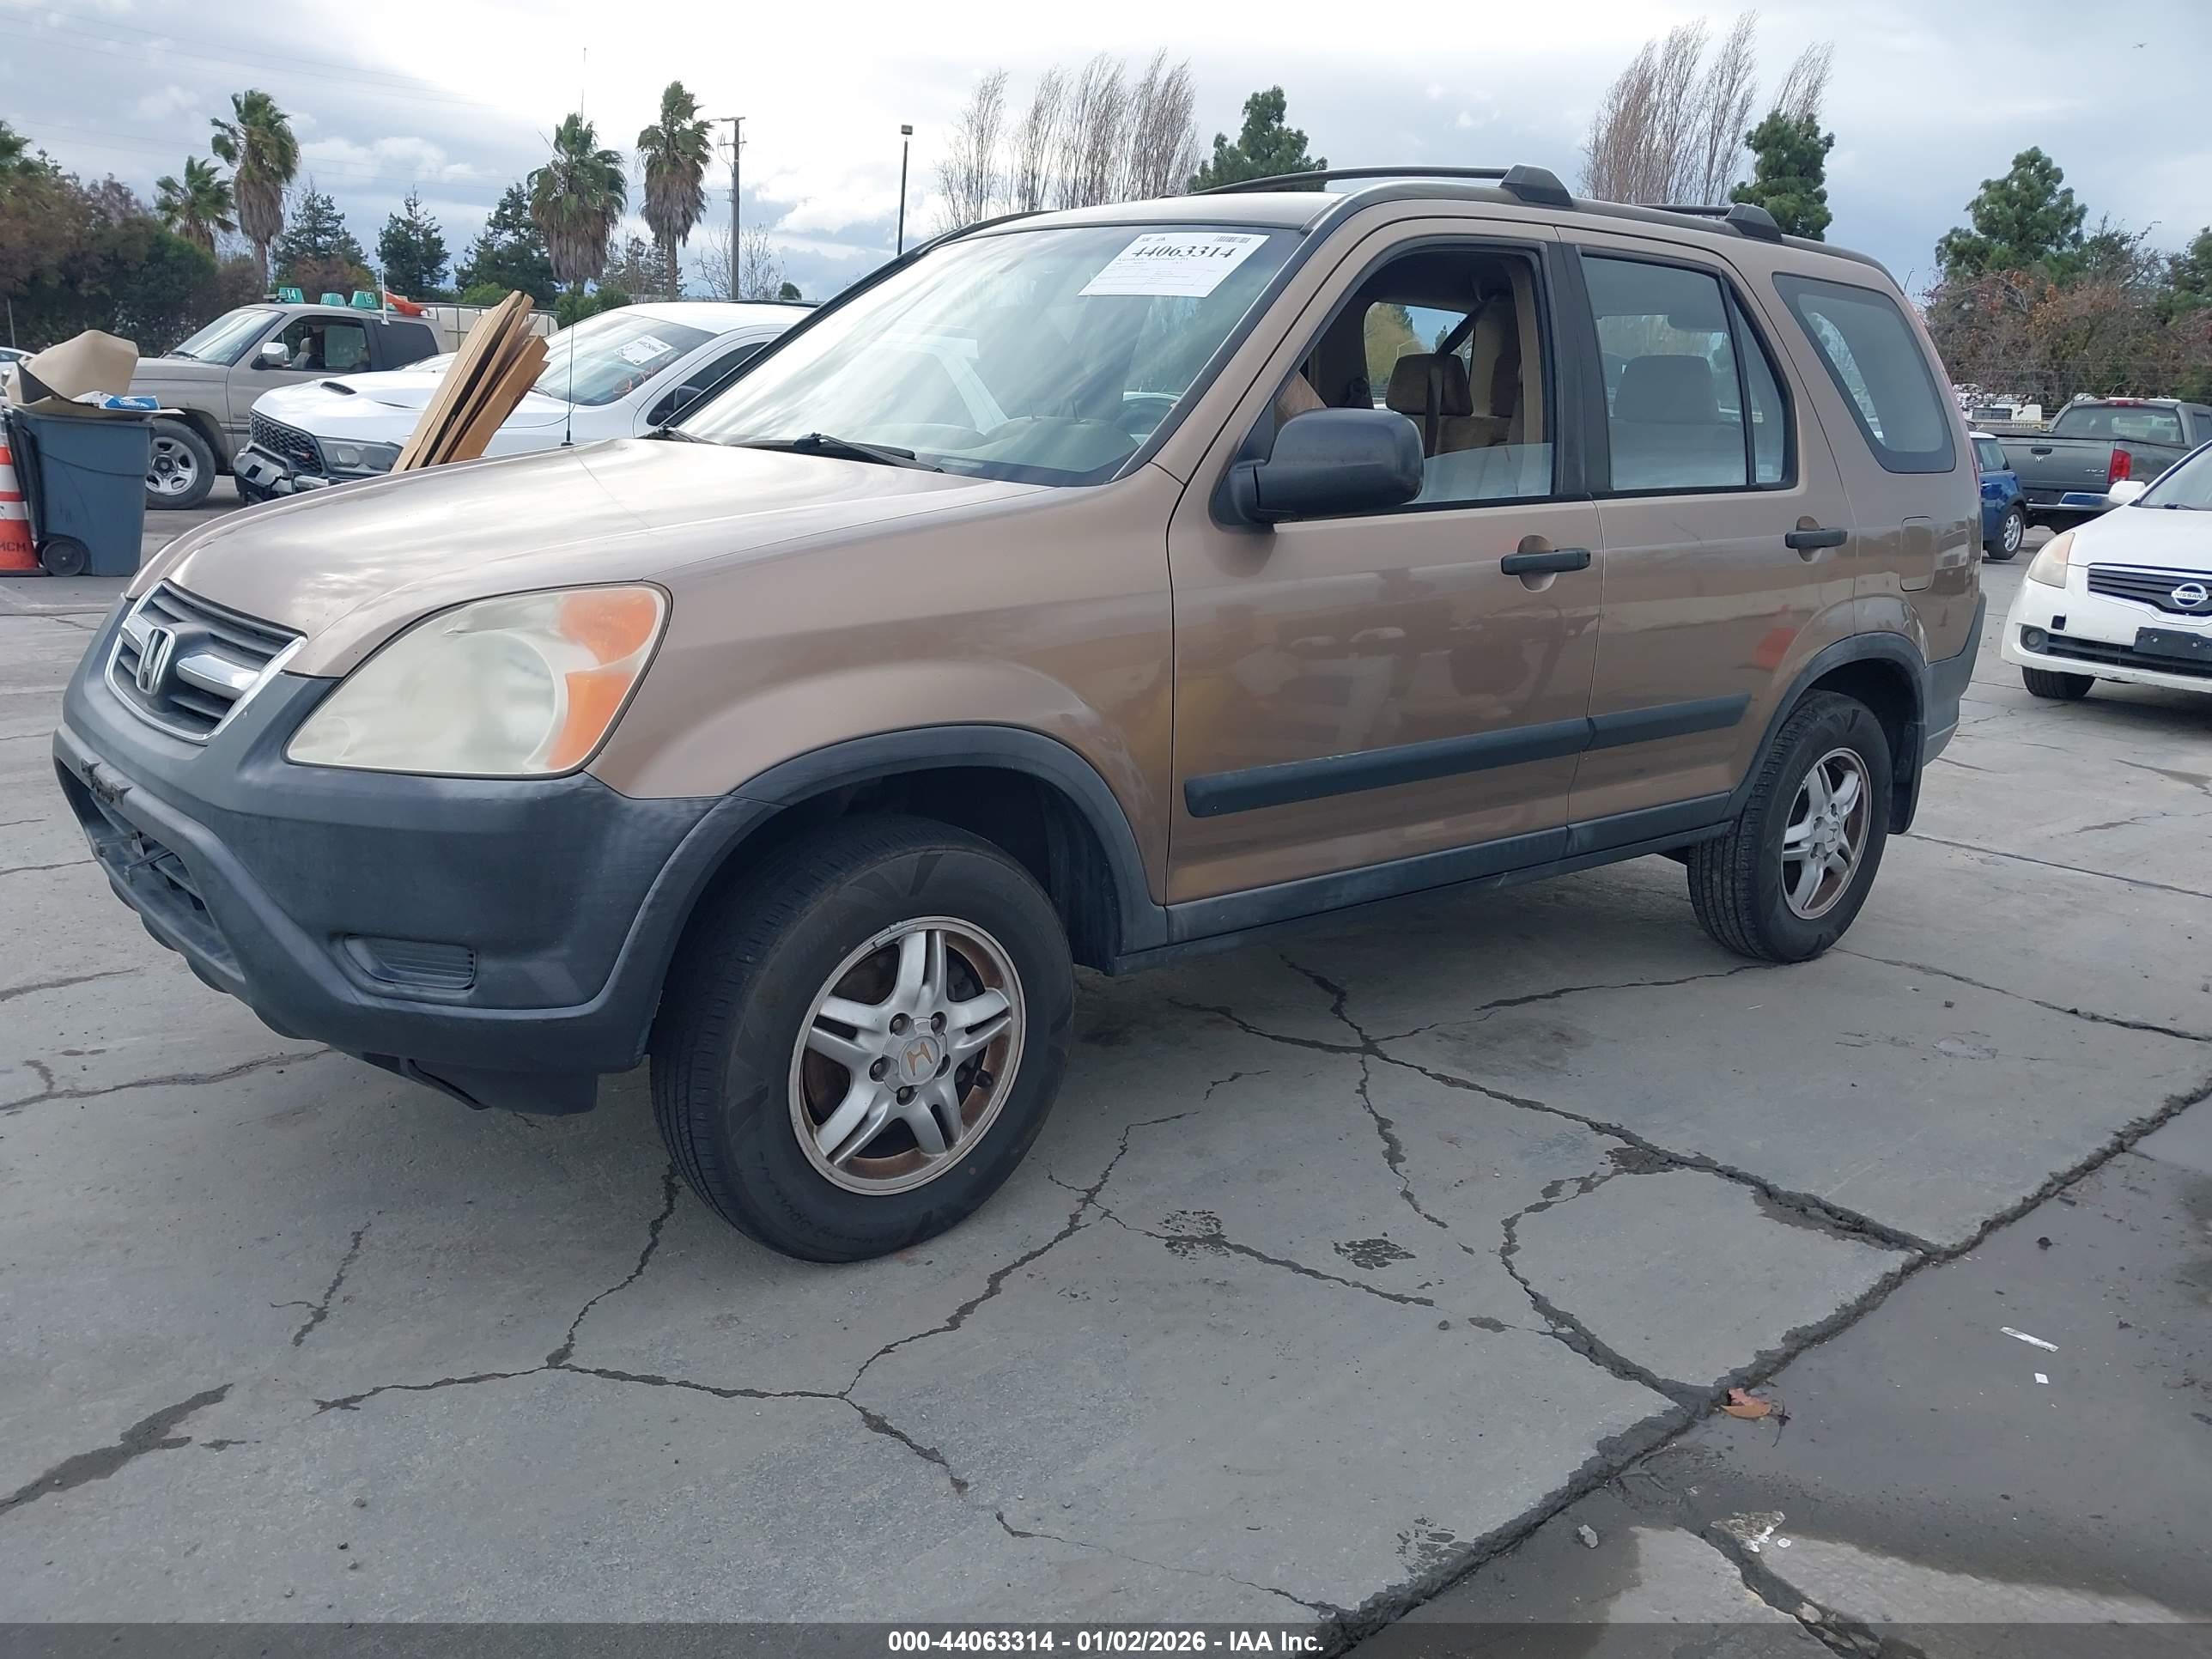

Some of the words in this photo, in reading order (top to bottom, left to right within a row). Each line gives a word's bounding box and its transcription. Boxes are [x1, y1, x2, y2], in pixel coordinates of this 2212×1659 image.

[1131, 245, 1237, 258] 44063314
[286, 289, 297, 300] 14
[2174, 591, 2203, 599] NISSAN
